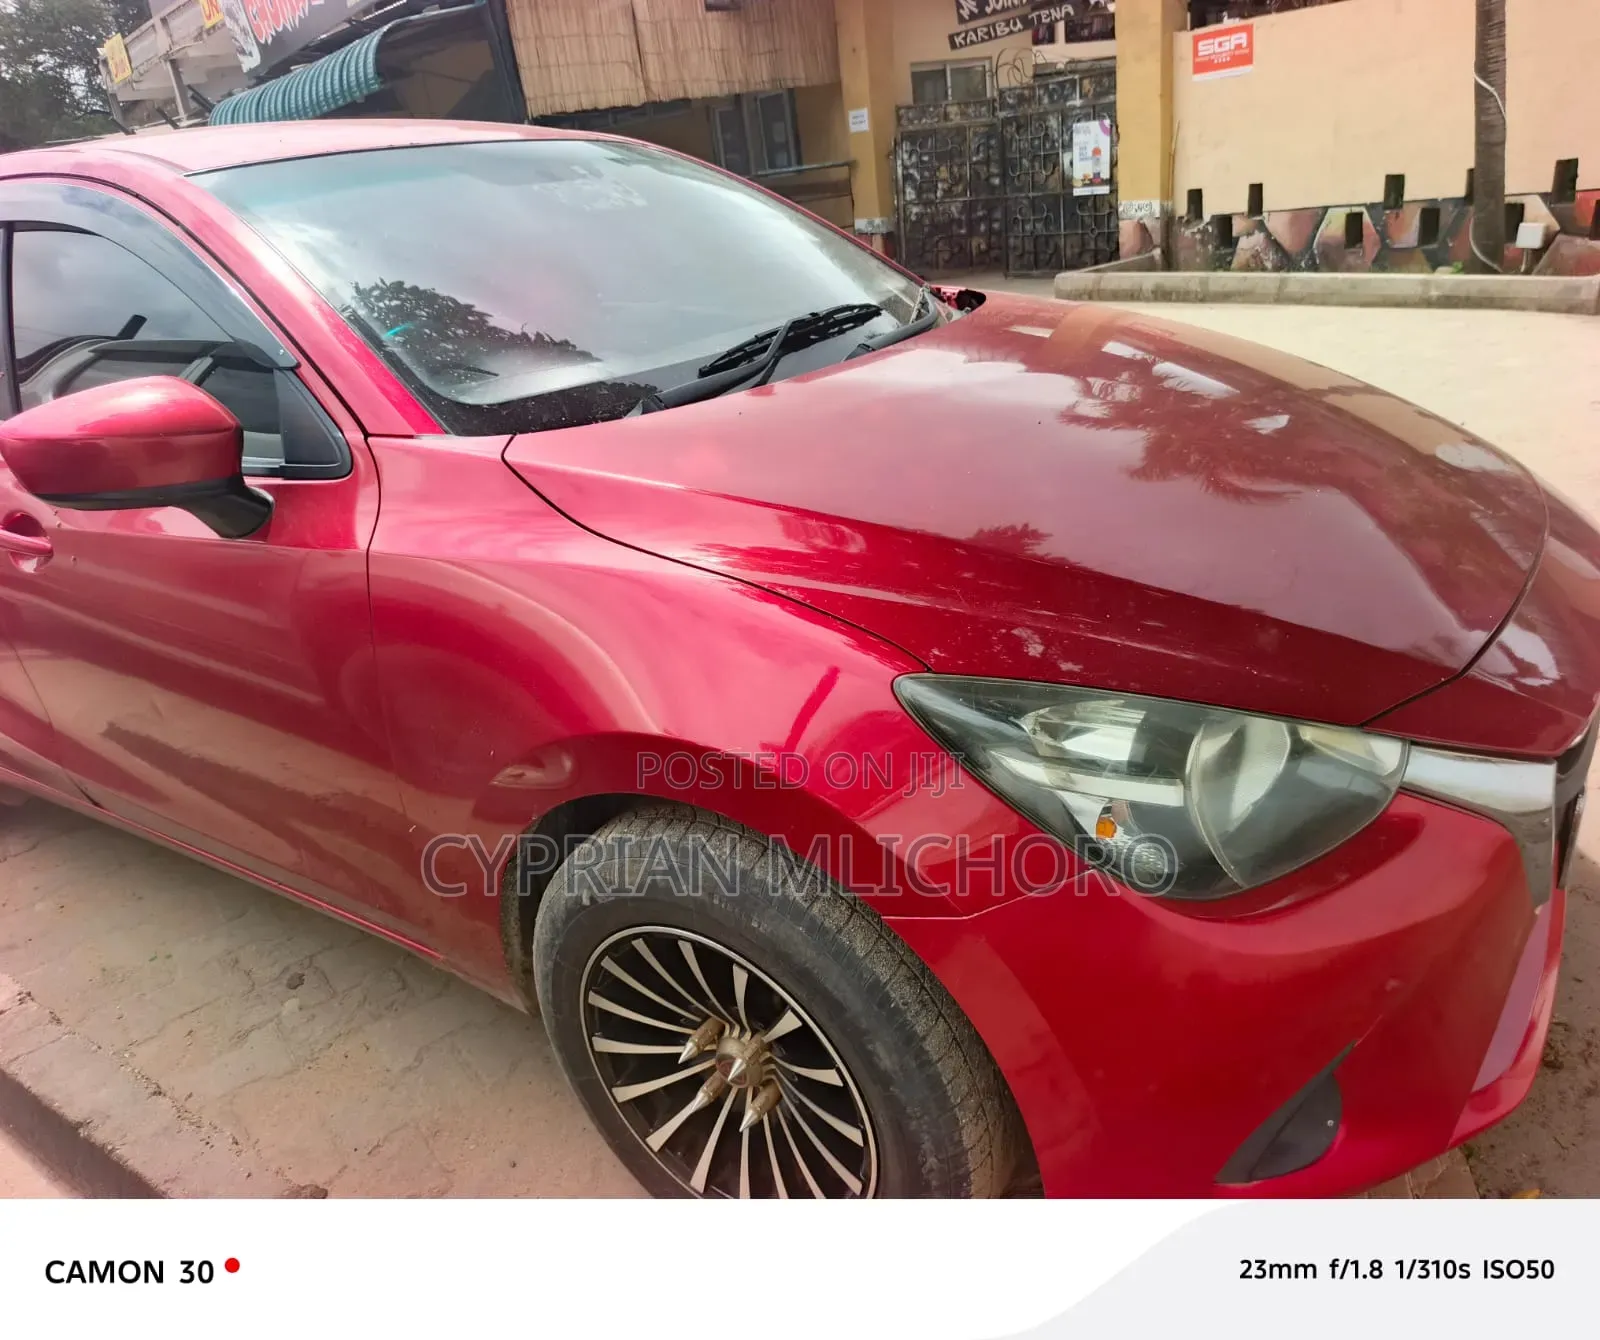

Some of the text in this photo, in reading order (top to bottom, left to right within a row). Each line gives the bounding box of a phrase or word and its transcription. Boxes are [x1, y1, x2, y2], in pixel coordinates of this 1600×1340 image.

[953, 4, 1075, 48] KARIBU TENA
[1197, 32, 1247, 57] SGA
